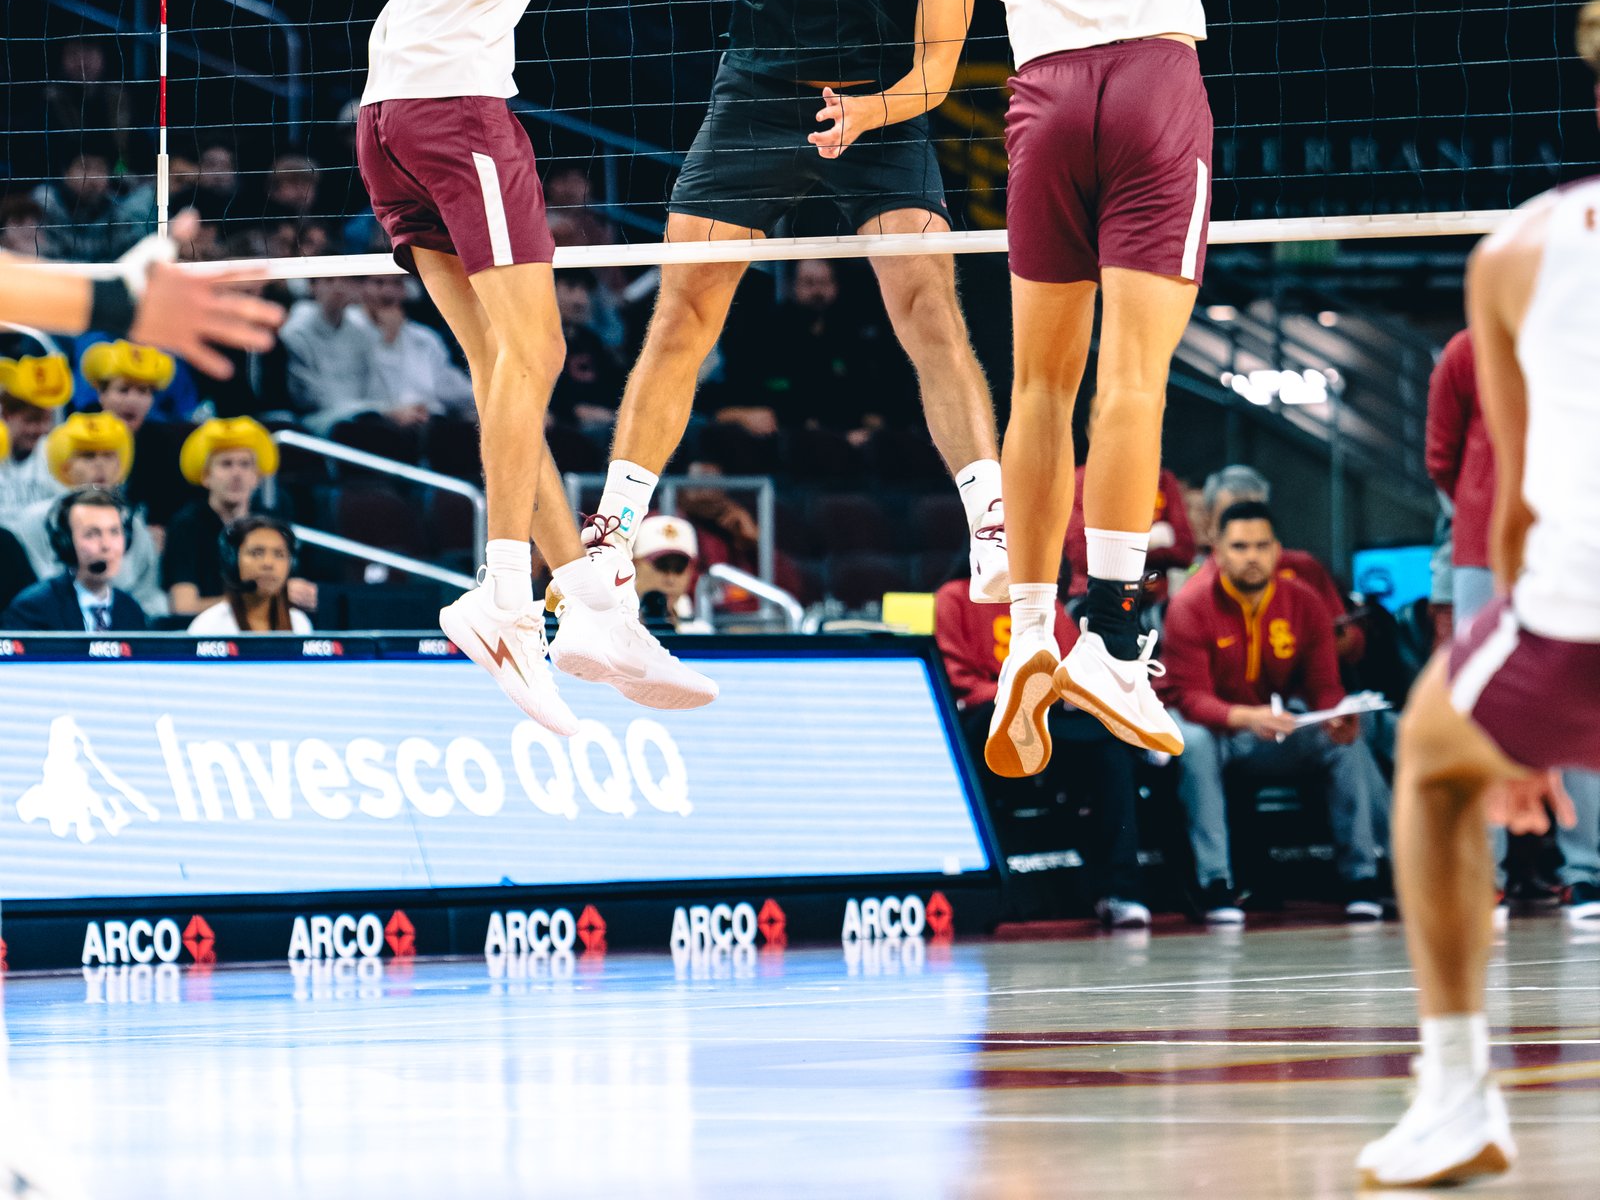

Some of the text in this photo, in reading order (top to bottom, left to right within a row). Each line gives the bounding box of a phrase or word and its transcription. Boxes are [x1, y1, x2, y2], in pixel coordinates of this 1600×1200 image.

[156, 714, 693, 822] Invesco QQQ
[288, 913, 384, 959] ARCO
[484, 908, 576, 953] ARCO
[670, 902, 758, 947] ARCO
[841, 895, 926, 940] ARCO
[82, 918, 181, 964] ARCO
